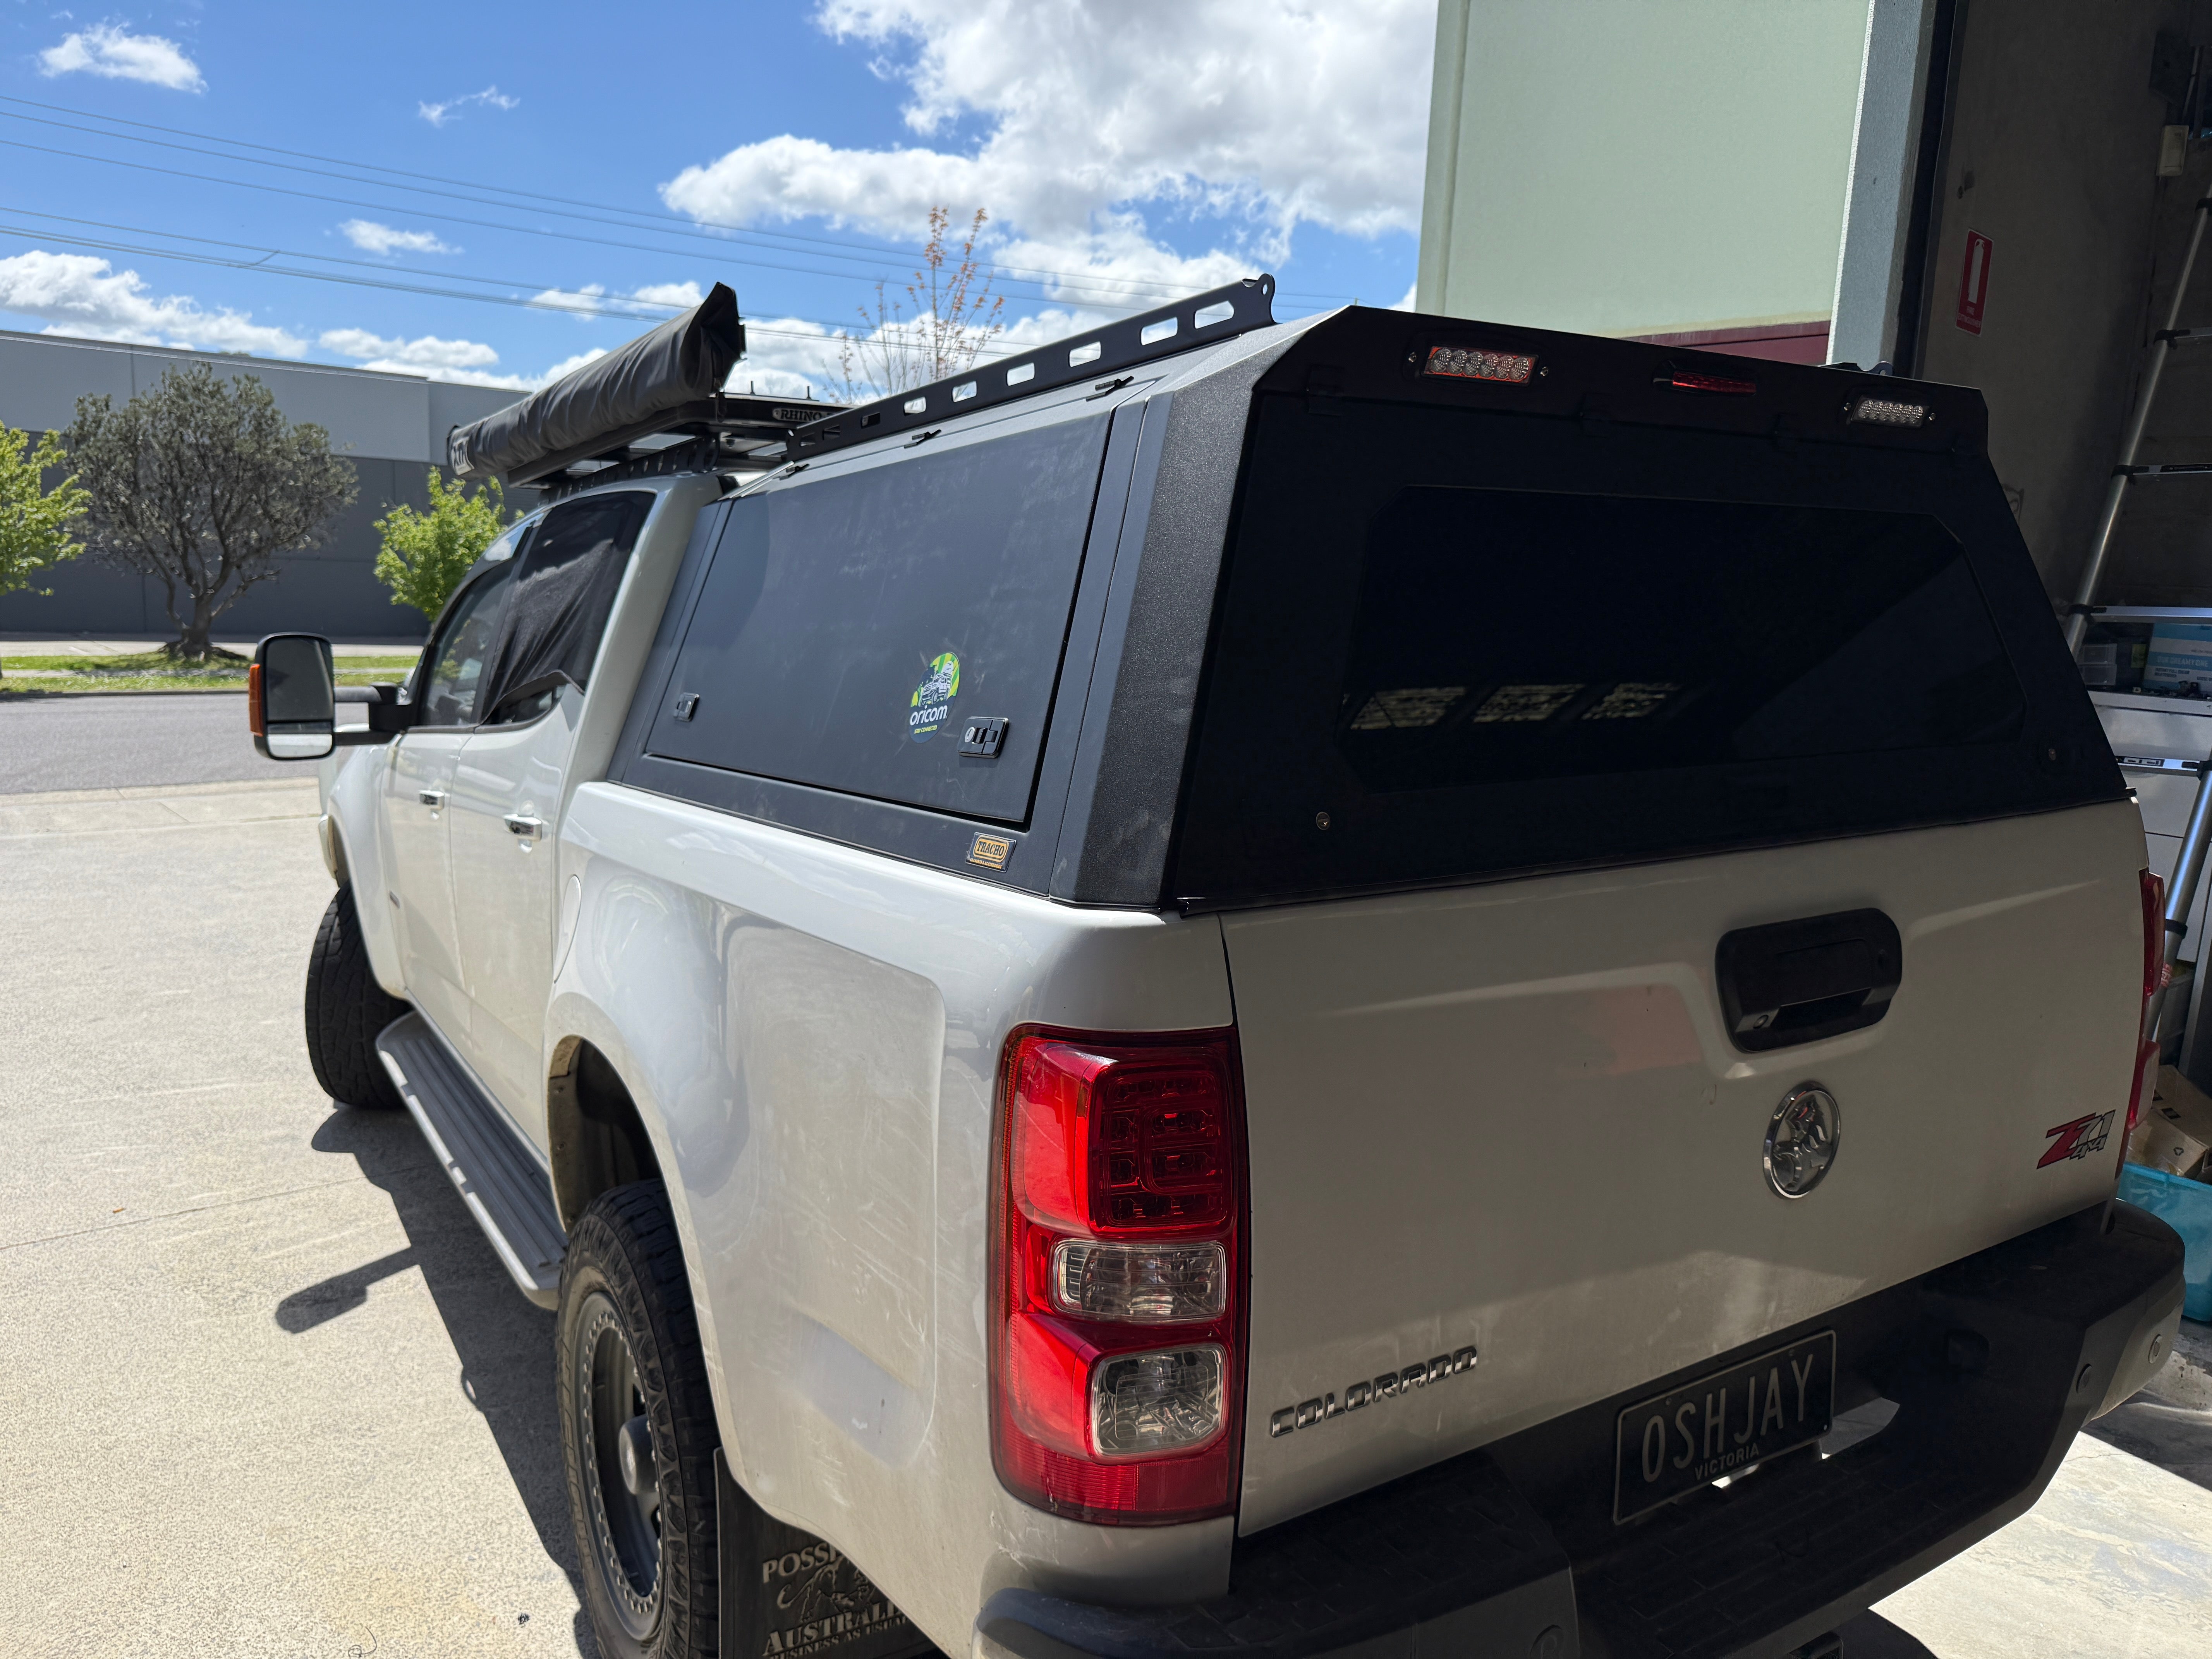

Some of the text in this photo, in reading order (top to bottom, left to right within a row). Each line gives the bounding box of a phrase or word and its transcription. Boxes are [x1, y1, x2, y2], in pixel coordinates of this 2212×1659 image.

[910, 705, 948, 726] oricom
[977, 841, 1005, 856] TRACHO
[2036, 1109, 2116, 1170] Z71
[1271, 1345, 1477, 1438] COLORADO
[1642, 1354, 1813, 1482] OSHJAY
[1695, 1443, 1759, 1481] VICTORIA
